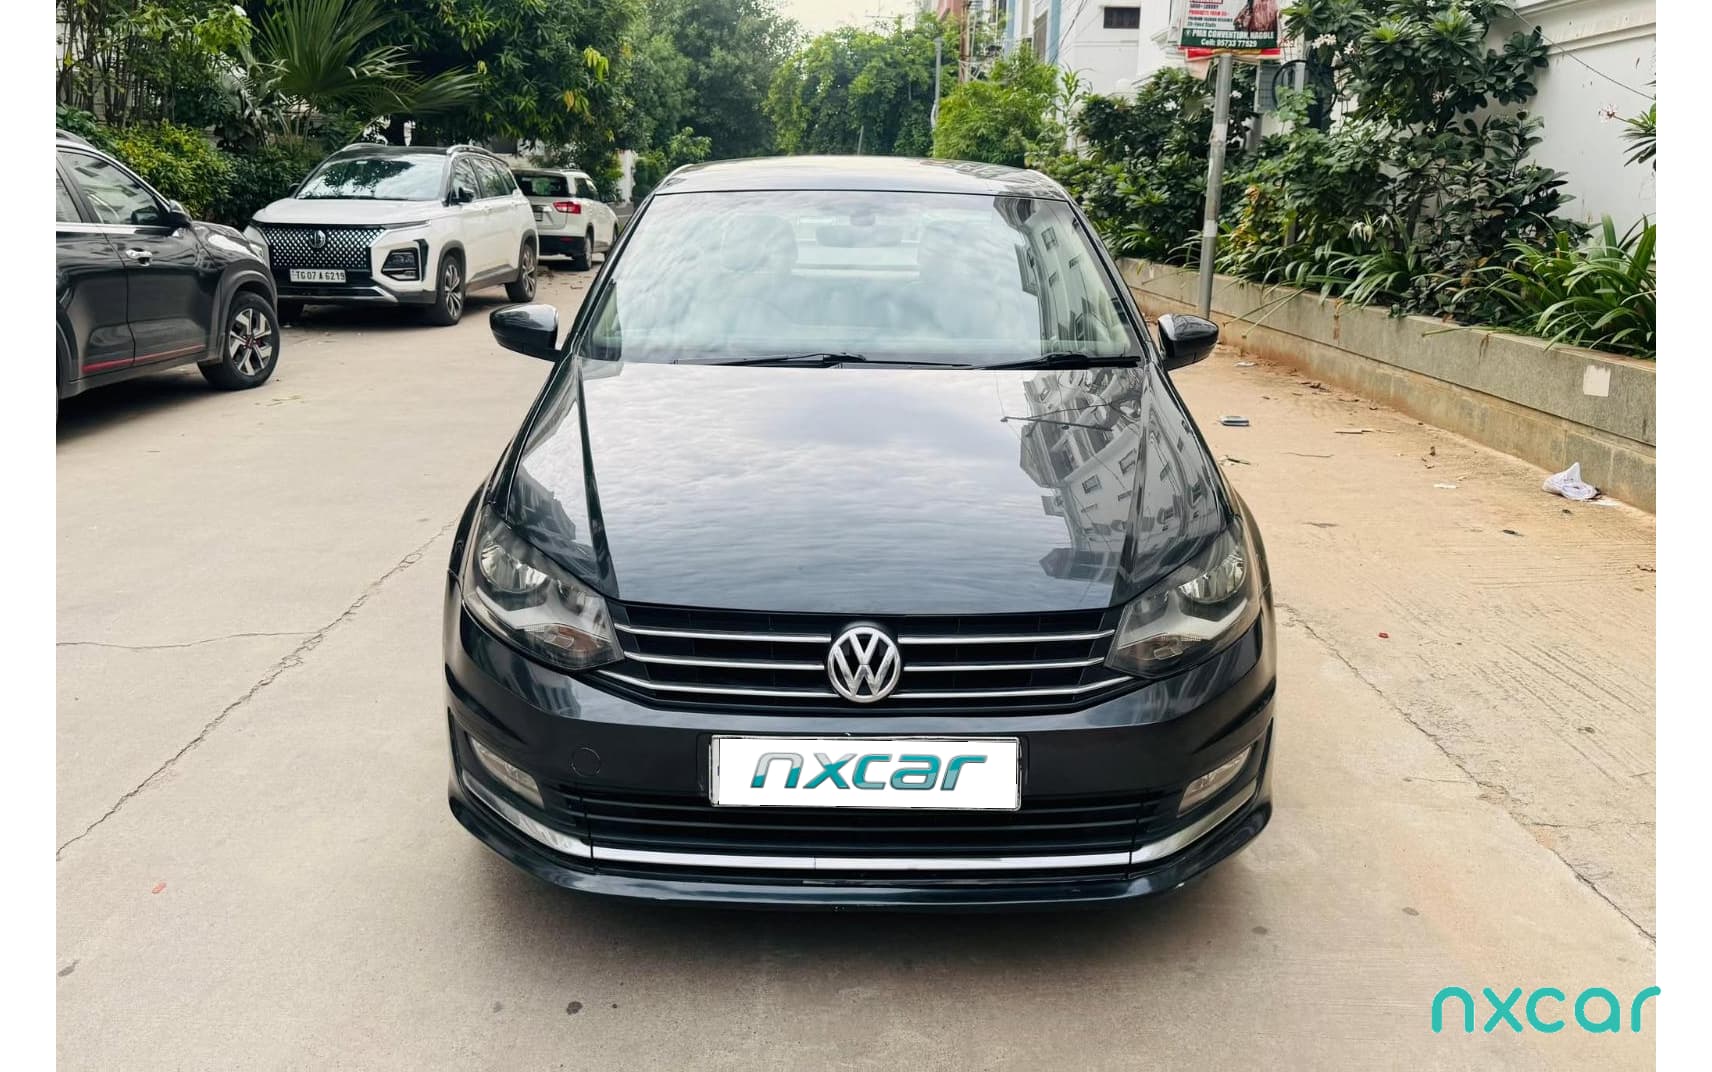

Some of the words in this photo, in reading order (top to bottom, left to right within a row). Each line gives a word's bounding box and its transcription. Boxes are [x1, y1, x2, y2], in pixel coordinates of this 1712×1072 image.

[295, 271, 306, 280] TG
[307, 271, 316, 280] 07
[325, 272, 345, 280] 6219
